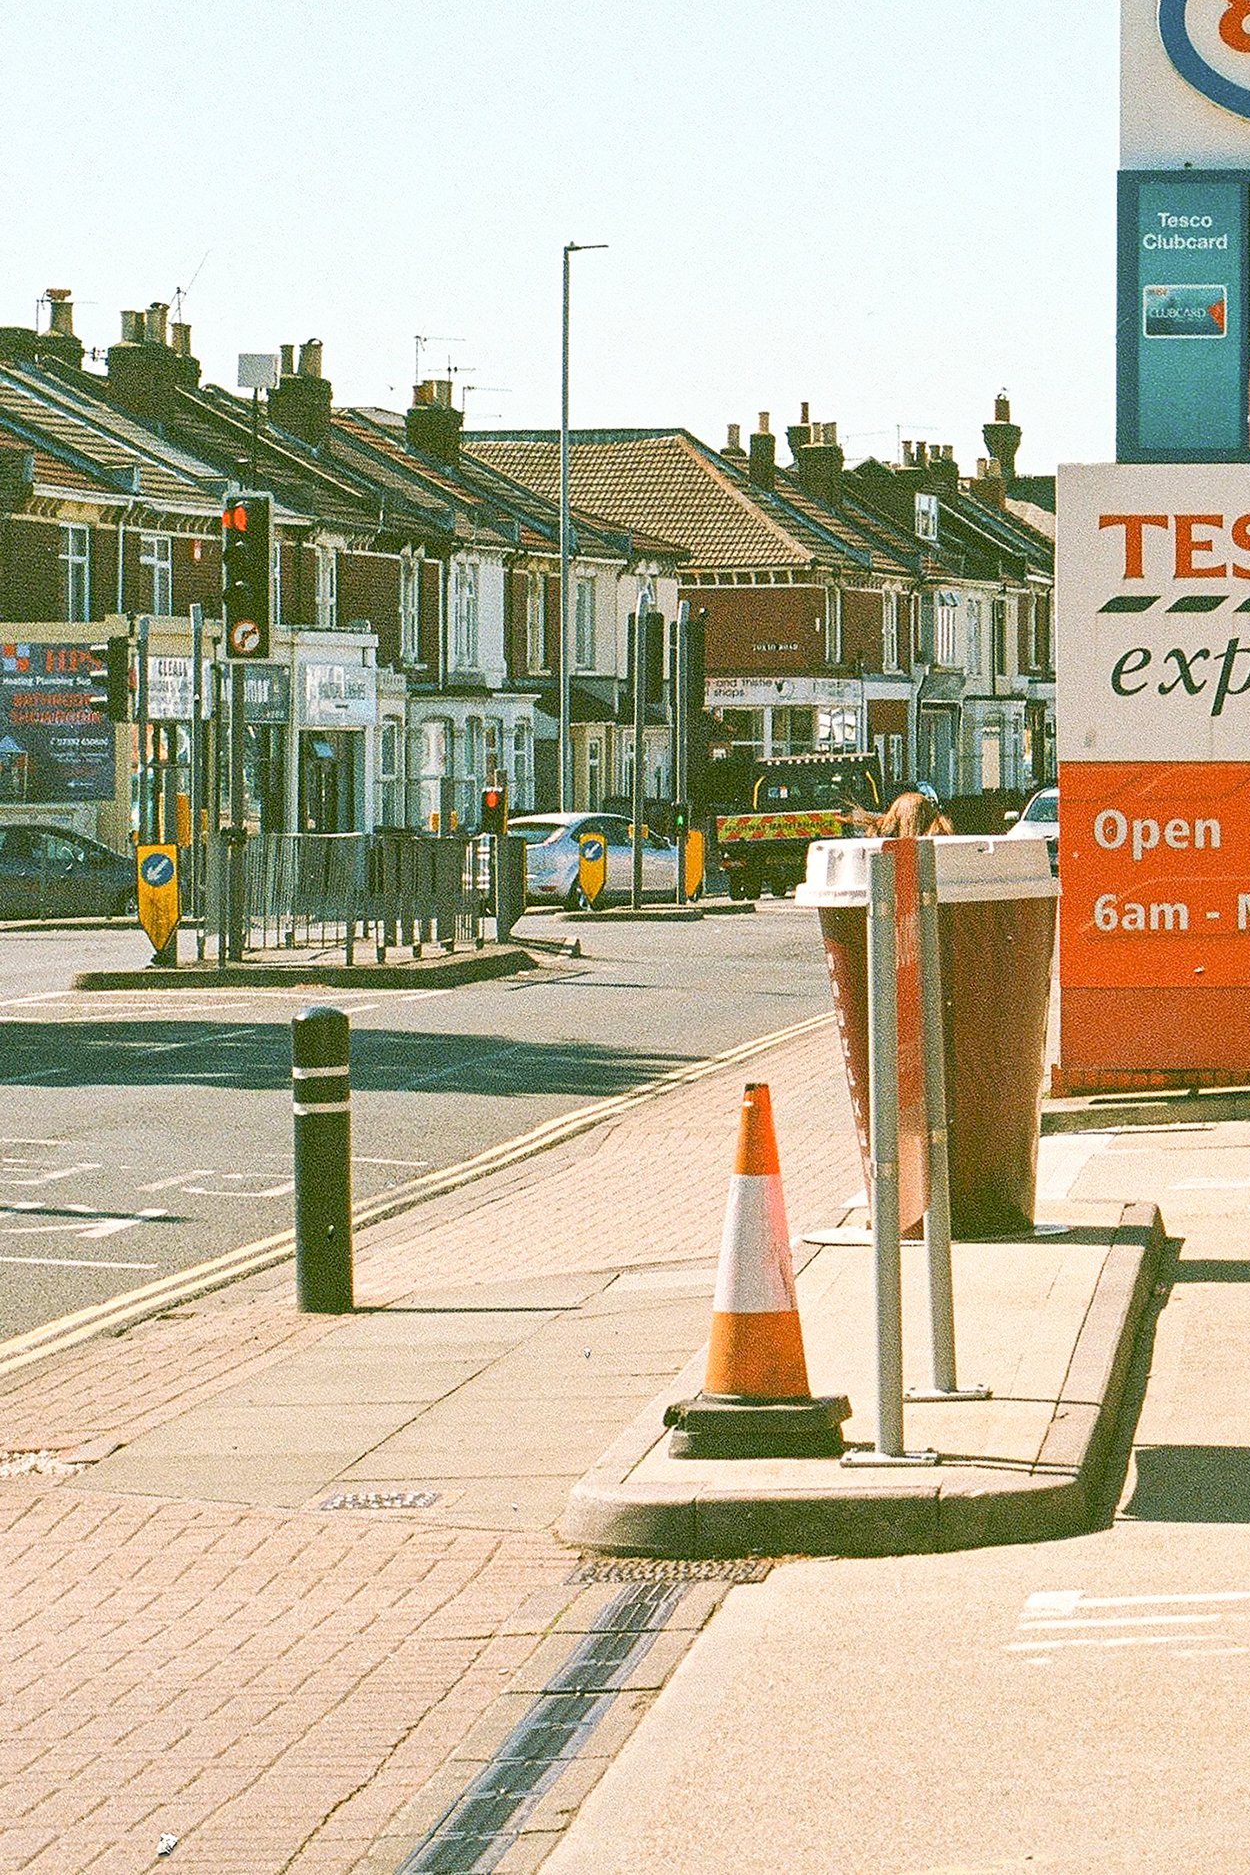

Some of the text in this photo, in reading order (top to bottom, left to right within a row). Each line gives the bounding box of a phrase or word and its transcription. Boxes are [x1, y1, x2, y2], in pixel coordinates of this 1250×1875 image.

[1157, 212, 1213, 228] Tesco
[1142, 233, 1229, 251] Clubcard
[1092, 808, 1222, 864] Open
[1092, 895, 1190, 932] 6am
